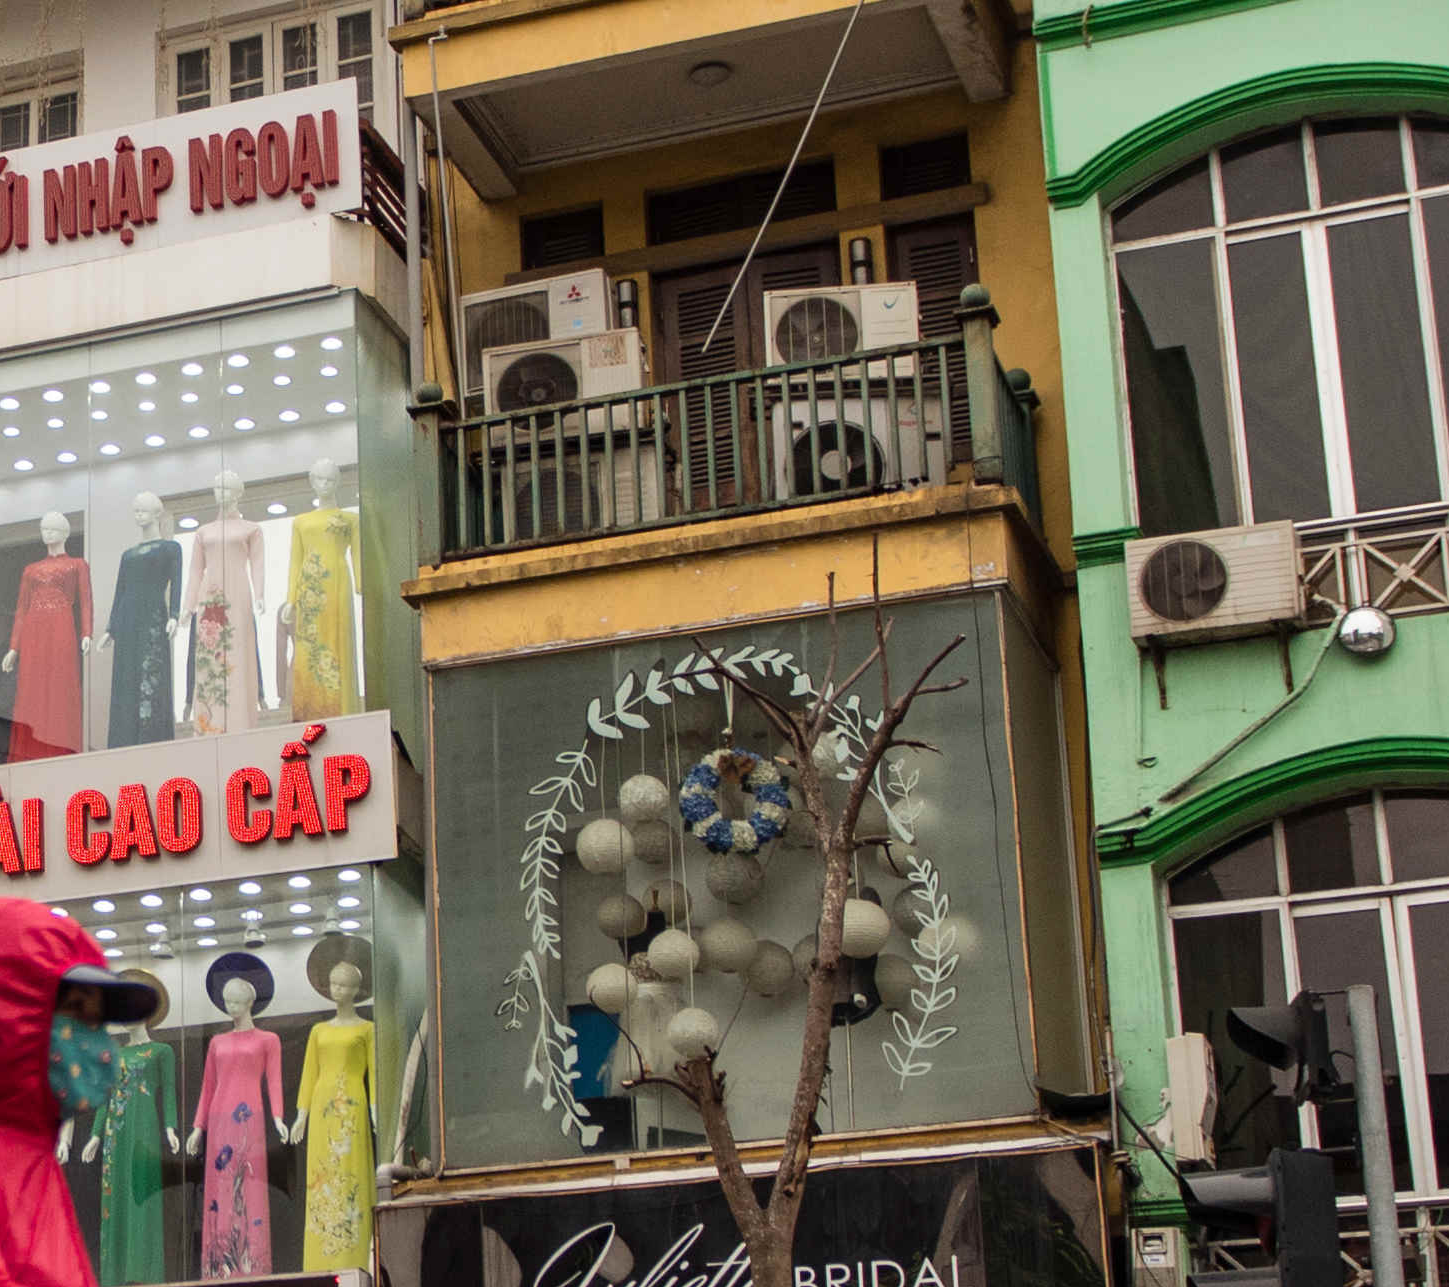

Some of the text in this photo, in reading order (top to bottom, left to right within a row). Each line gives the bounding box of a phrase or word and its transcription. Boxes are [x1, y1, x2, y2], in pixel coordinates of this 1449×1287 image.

[43, 135, 174, 245] NHẬP
[188, 108, 340, 214] NGOẠI
[65, 775, 204, 866] CAO
[226, 723, 373, 845] CẤP
